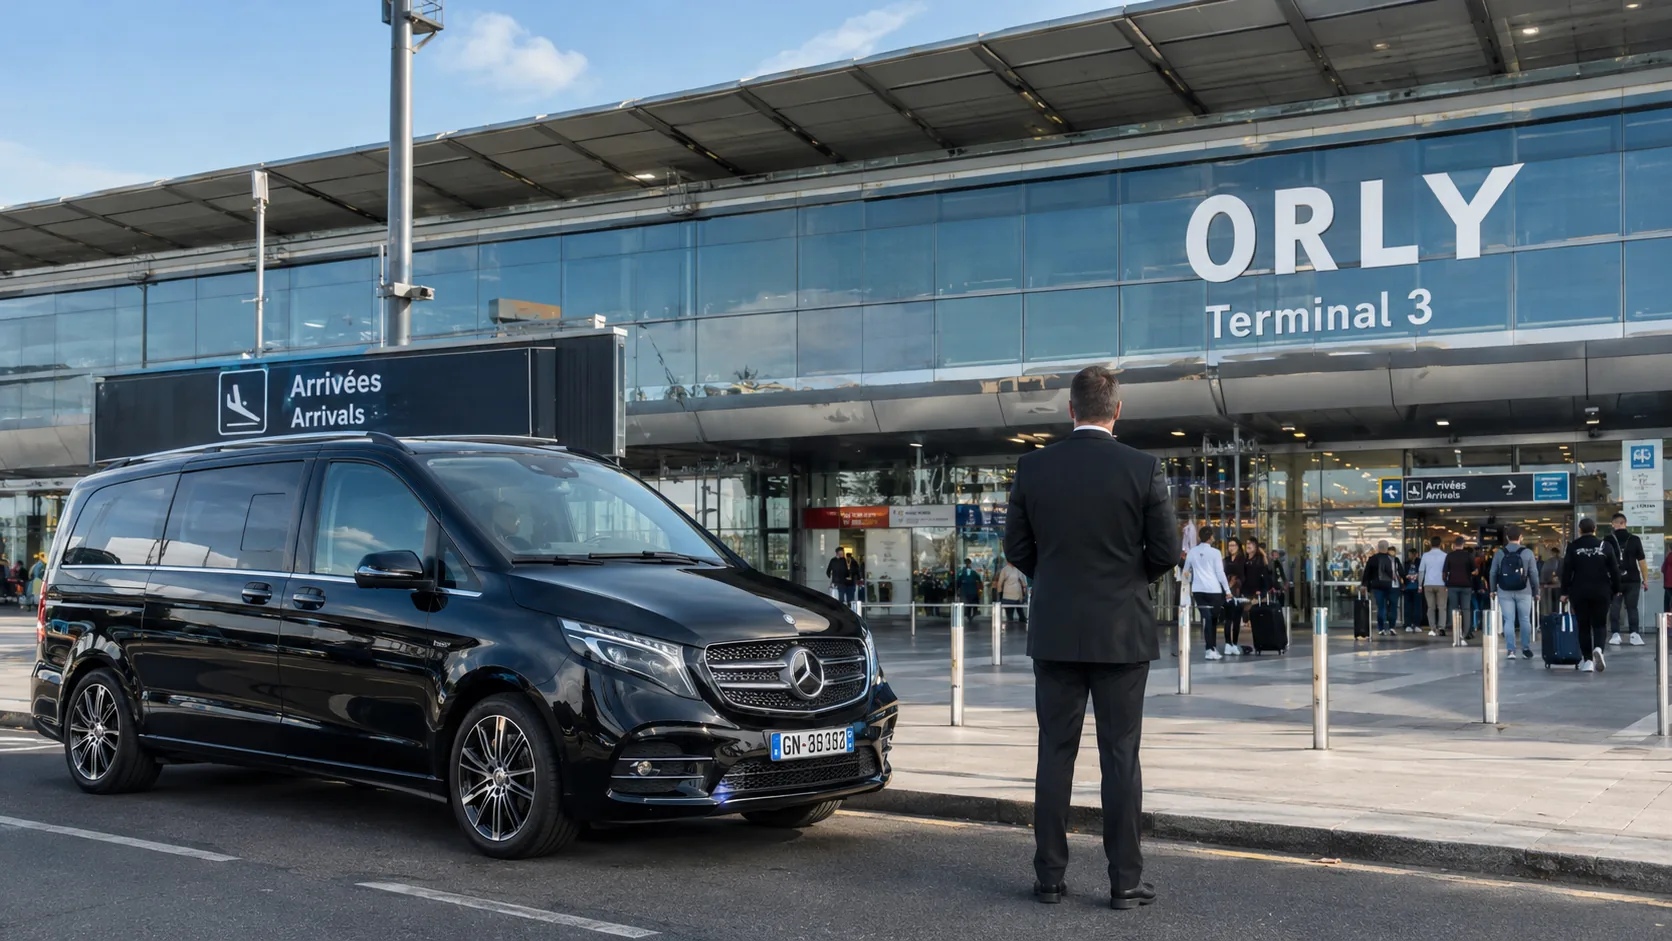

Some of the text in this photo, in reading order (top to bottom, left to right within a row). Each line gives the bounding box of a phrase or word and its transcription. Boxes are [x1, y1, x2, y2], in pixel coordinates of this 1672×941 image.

[1186, 163, 1525, 282] ORLY
[1205, 288, 1432, 339] Terminal 3
[290, 369, 381, 398] Arrivées
[291, 403, 364, 428] Arrivals
[1426, 481, 1467, 491] Arrivées
